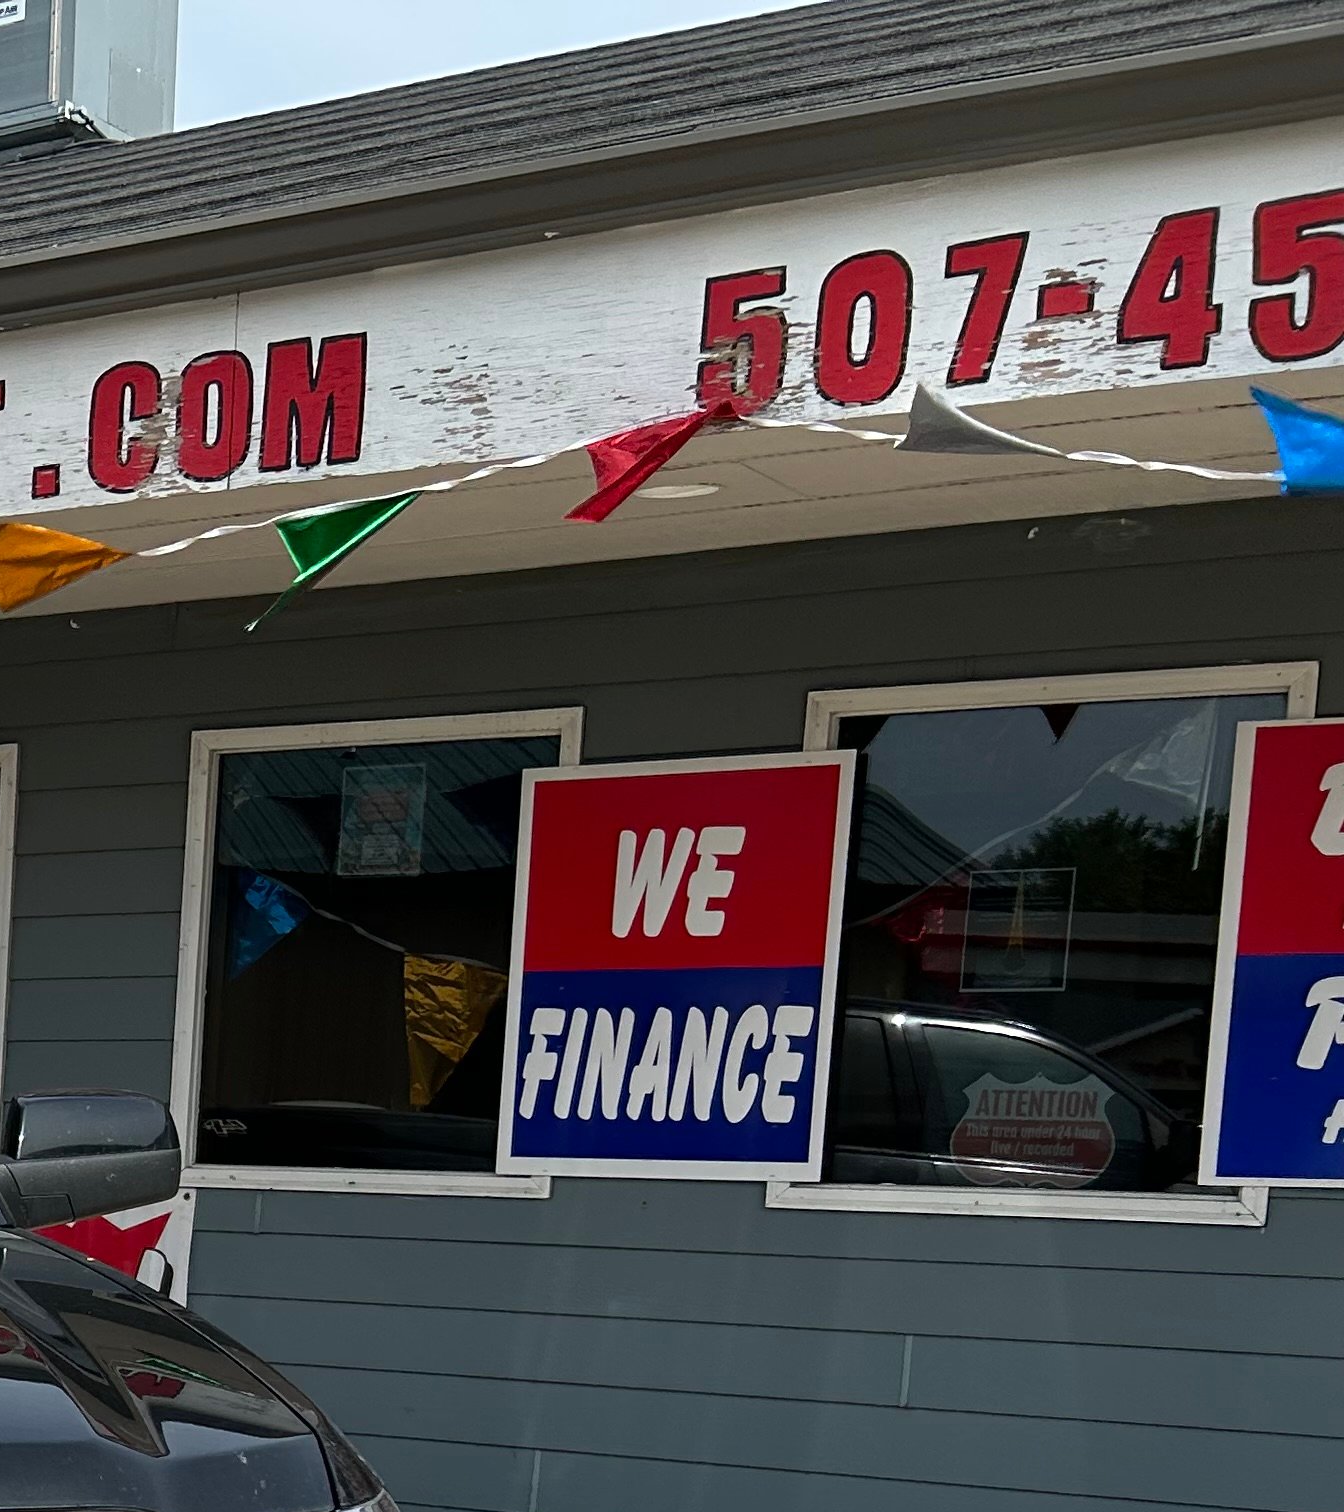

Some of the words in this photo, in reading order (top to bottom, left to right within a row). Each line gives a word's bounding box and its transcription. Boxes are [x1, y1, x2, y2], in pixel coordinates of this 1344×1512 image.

[611, 826, 746, 938] WE
[518, 1005, 814, 1124] FINANCE
[975, 1089, 1099, 1119] ATTENTION
[966, 1123, 989, 1138] This
[992, 1126, 1016, 1138] area
[1020, 1125, 1055, 1139] under
[1056, 1125, 1072, 1139] 24
[1074, 1126, 1101, 1140] hour
[990, 1141, 1012, 1155] live
[1023, 1143, 1075, 1157] recorded
